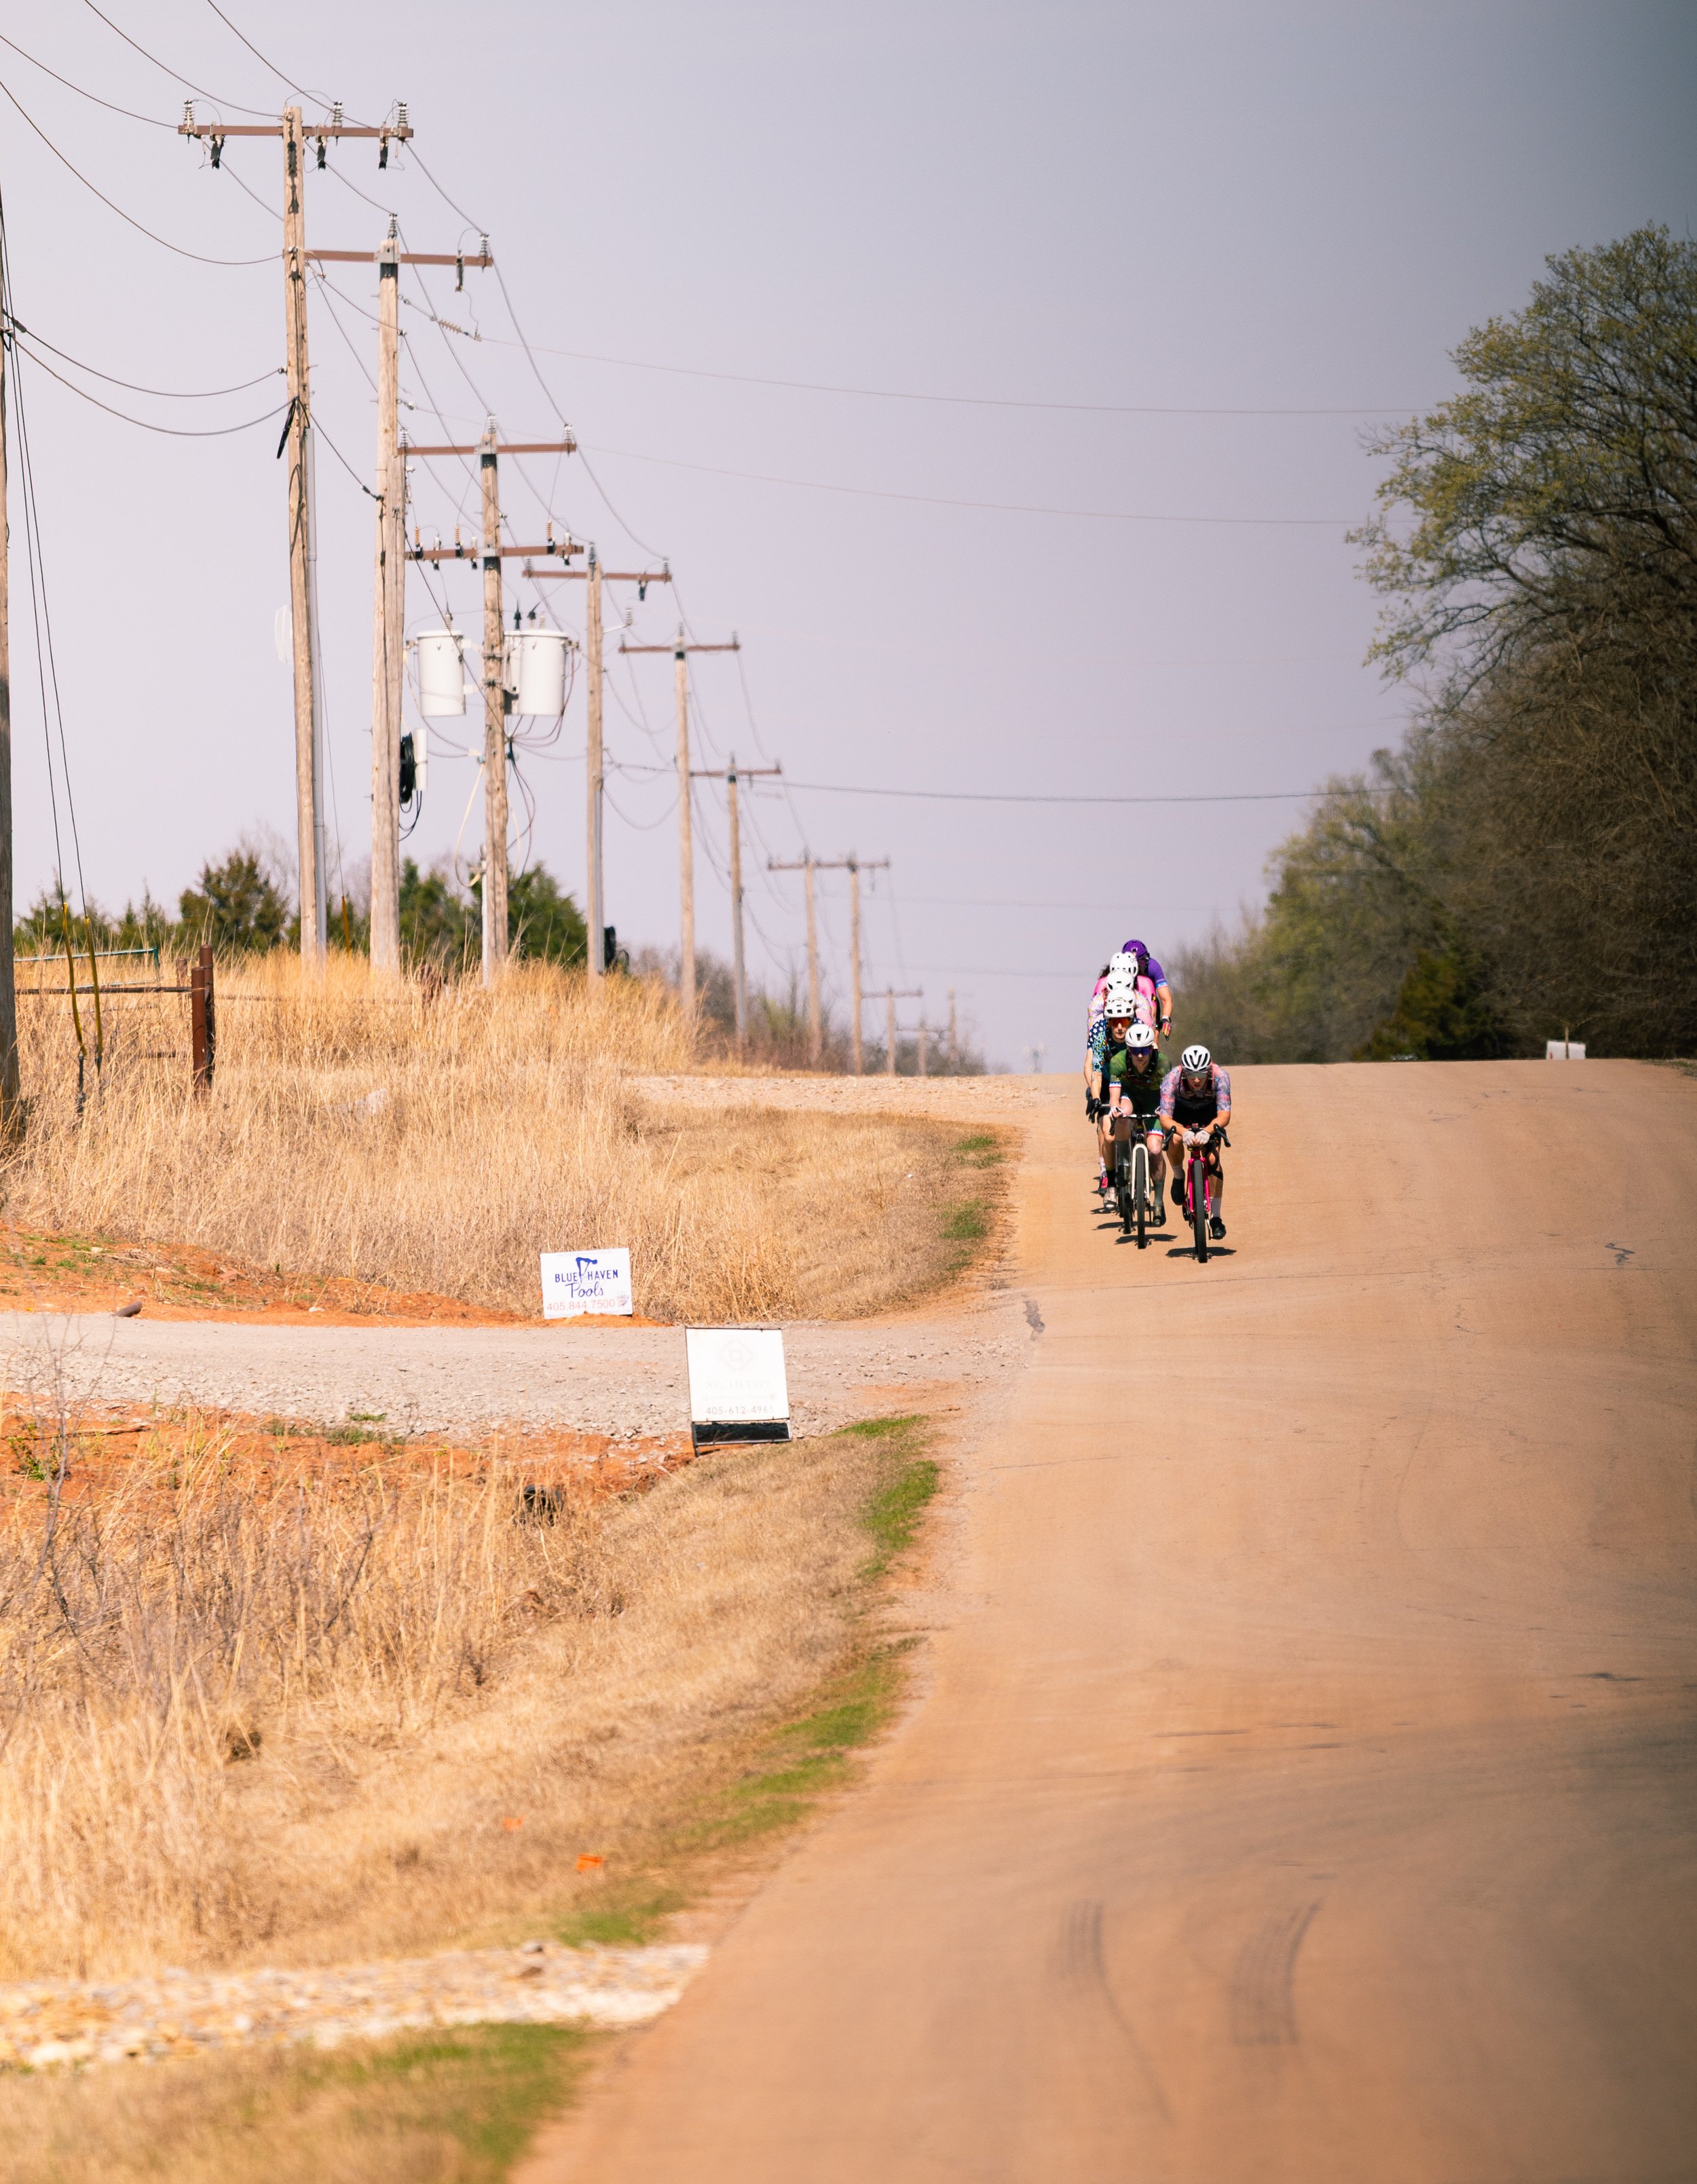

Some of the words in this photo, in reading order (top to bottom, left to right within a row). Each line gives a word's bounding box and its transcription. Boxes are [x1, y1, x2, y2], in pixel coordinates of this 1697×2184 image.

[555, 1272, 578, 1282] BLUE
[587, 1270, 618, 1280] HAVEN
[565, 1281, 603, 1298] Pools
[706, 1405, 775, 1414] 405-612-4965
